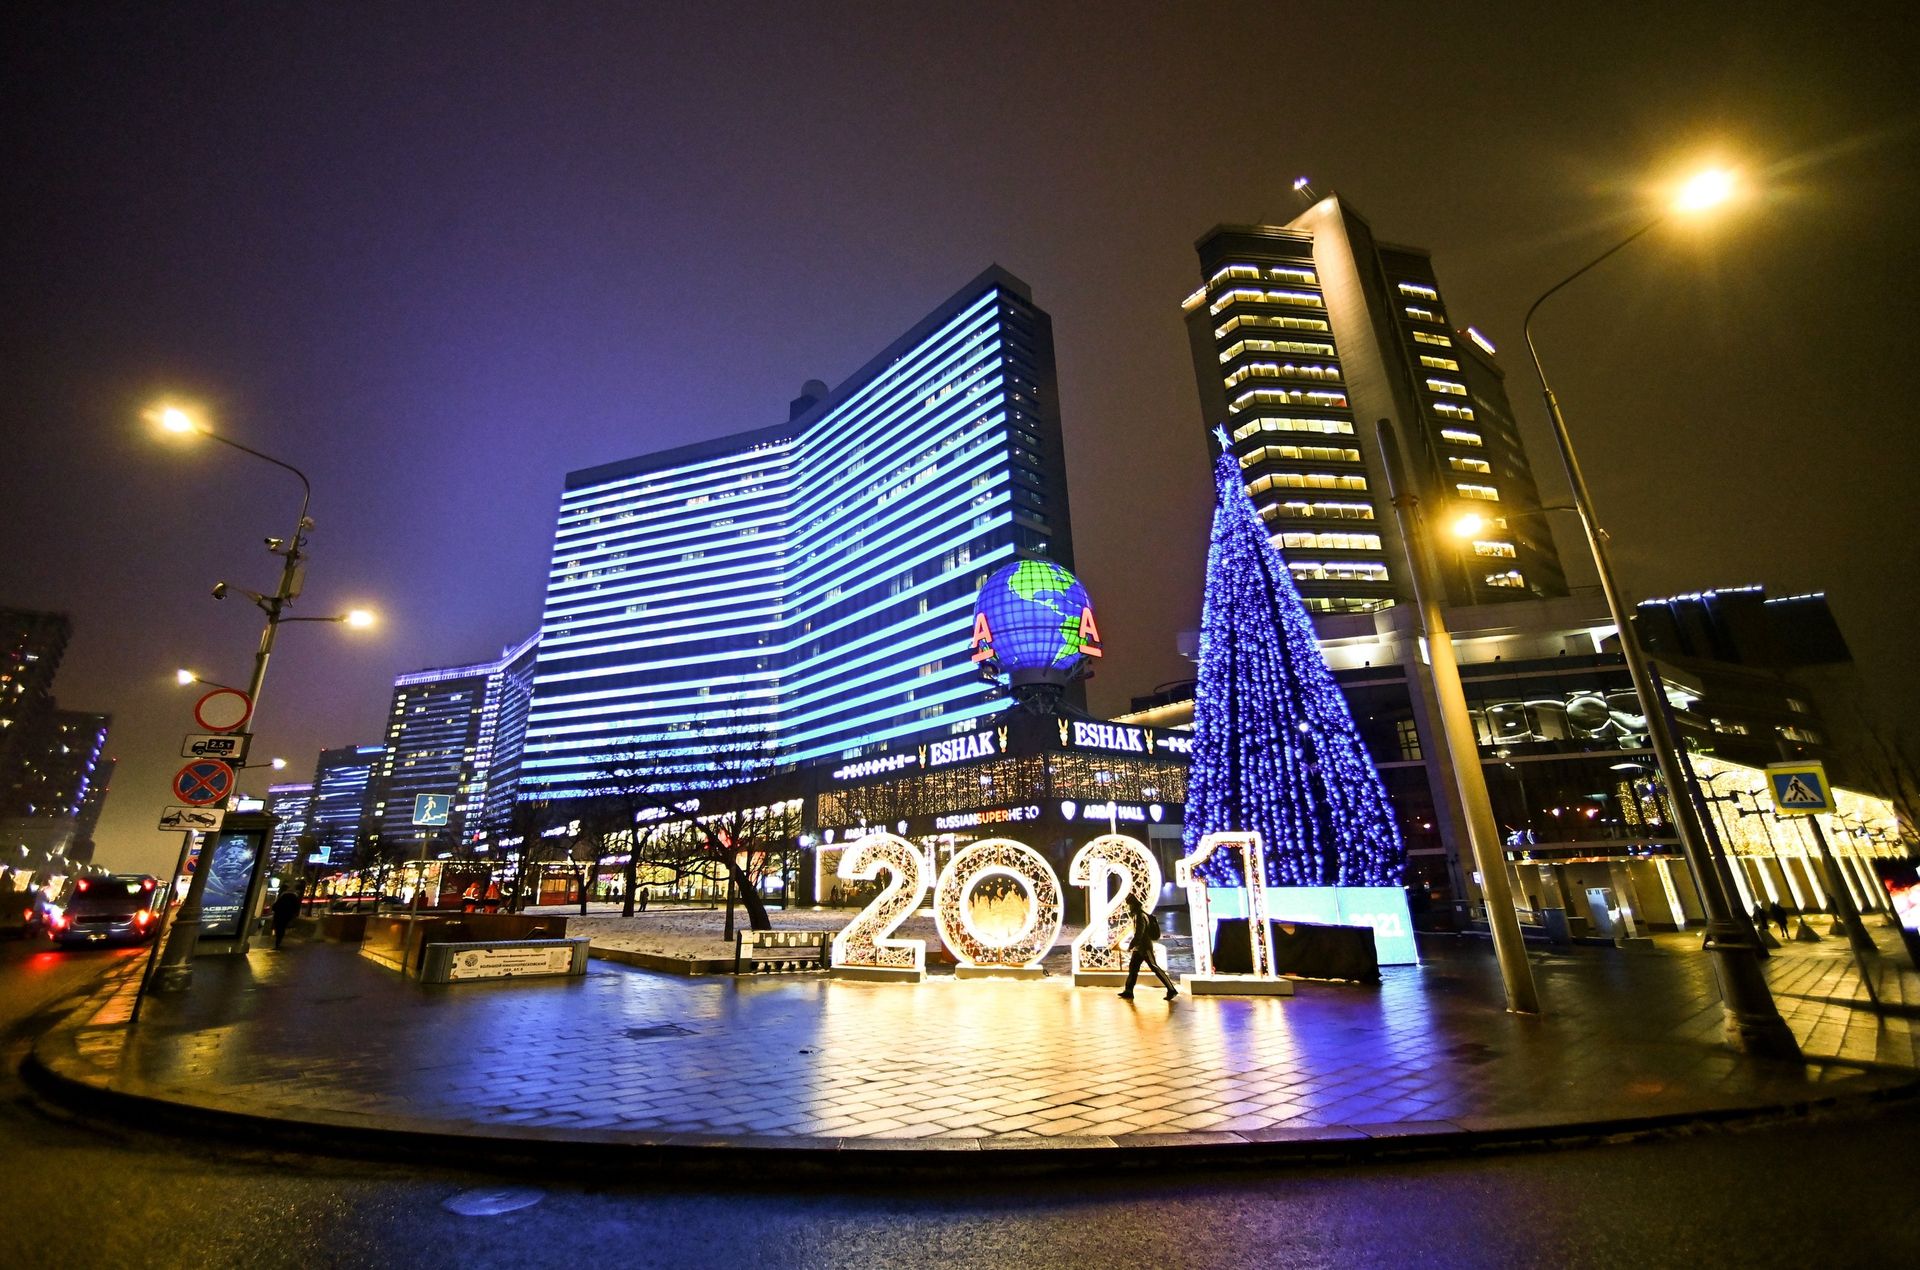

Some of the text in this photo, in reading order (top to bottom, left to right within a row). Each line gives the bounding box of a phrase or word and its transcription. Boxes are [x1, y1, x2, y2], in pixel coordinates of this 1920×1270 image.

[930, 730, 996, 766] ESHAK
[1073, 721, 1144, 752] ESHAK
[1083, 804, 1145, 821] ARBA HALL
[833, 831, 1278, 979] 2021
